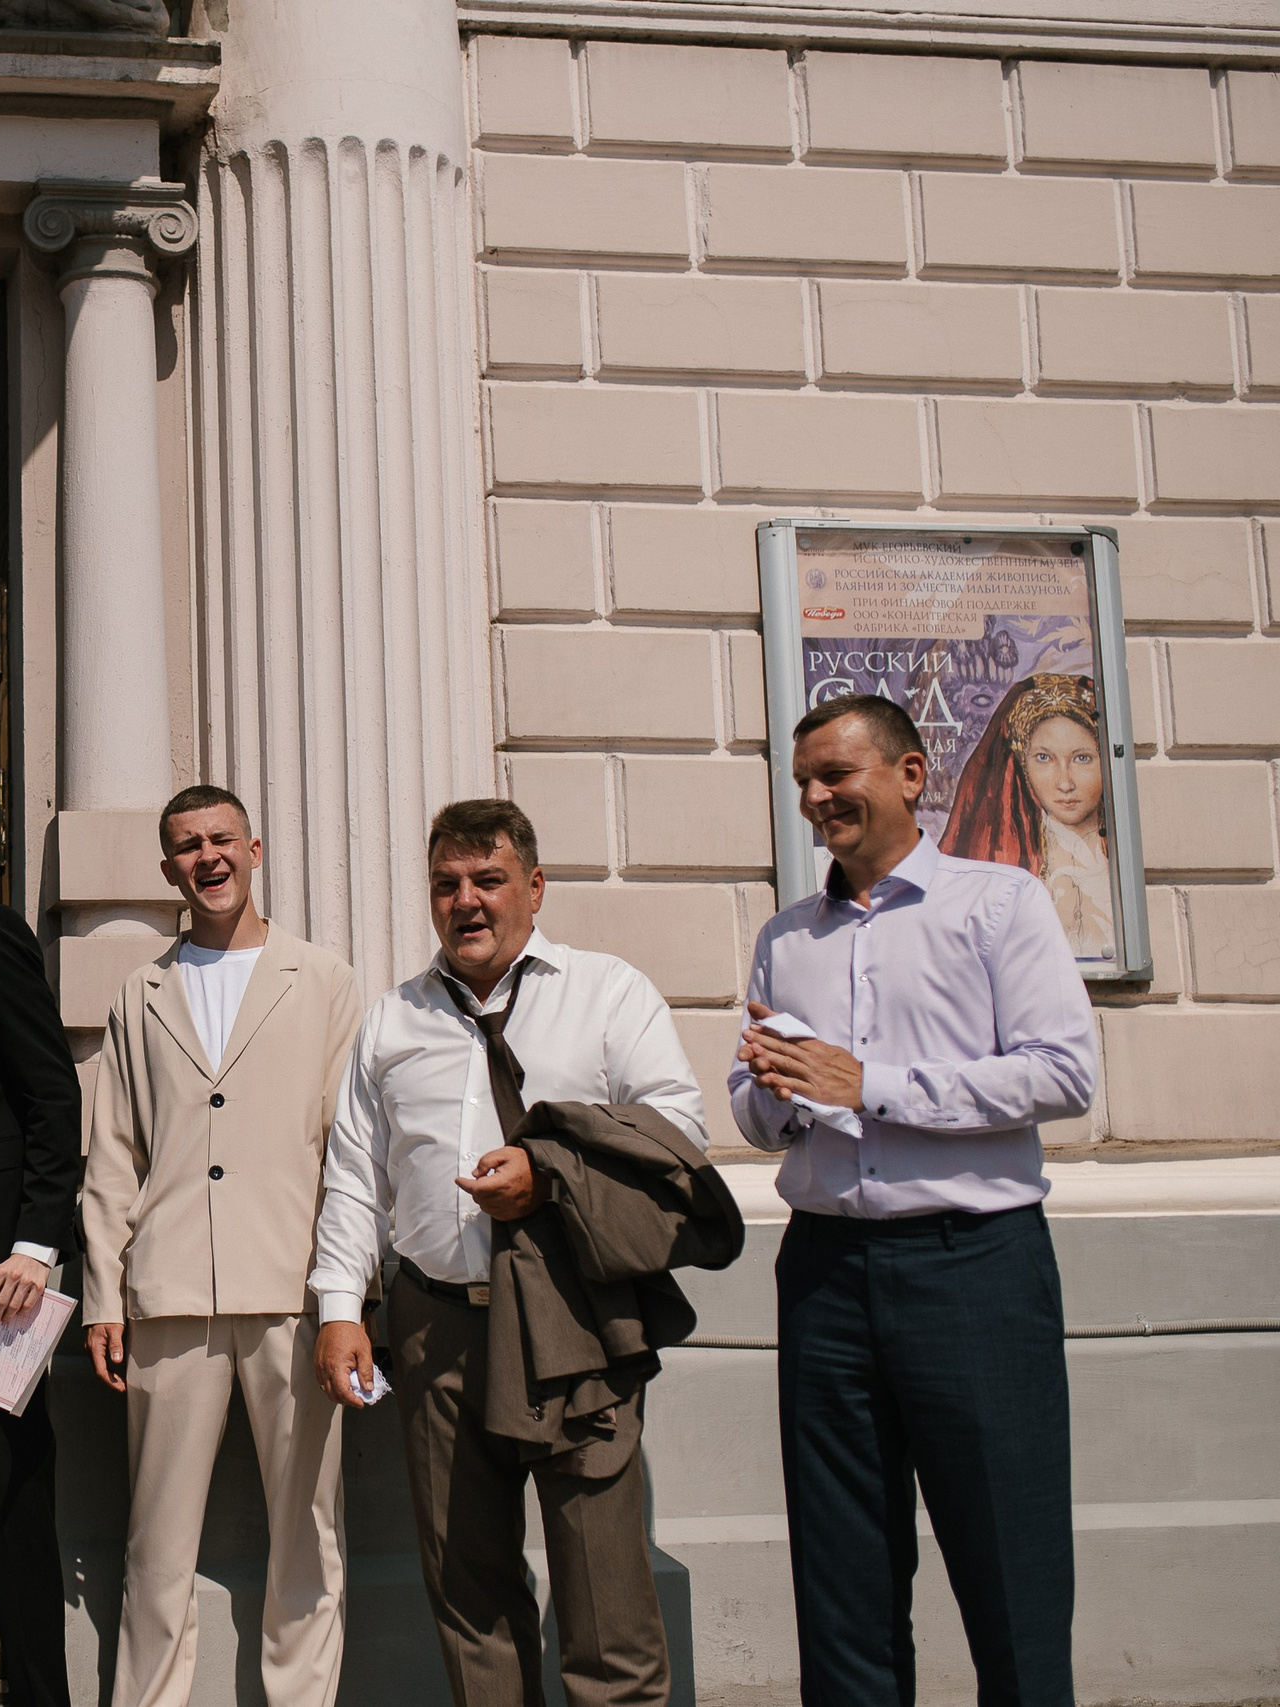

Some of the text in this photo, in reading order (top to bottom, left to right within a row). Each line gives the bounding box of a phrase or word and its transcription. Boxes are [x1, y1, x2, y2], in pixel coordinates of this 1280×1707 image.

[853, 542, 962, 553] МУК ЕГОРЬЕВСКИЙ
[854, 554, 1037, 567] ИСТОРИКО-ХУДОЖЕСТВЕННЫЙ
[834, 567, 1061, 584] РОССИЙСКАЯ АКАДЕМИЯ ЖИВОПИСИ,
[835, 581, 1071, 596] ВАЯНИЯ И ЗОДЧЕСТВА ИЛЬИ ГЛАЗУНОВА
[853, 597, 1037, 611] ПРИ ФИНАНСОВОЙ ПОДДЕРЖКЕ
[805, 608, 844, 620] Победа
[853, 610, 978, 622] ООО «КОНДИТЕРСКАЯ
[853, 622, 967, 635] ФАБРИКА «ПОБЕДА»
[809, 651, 955, 675] РУССКИЙ
